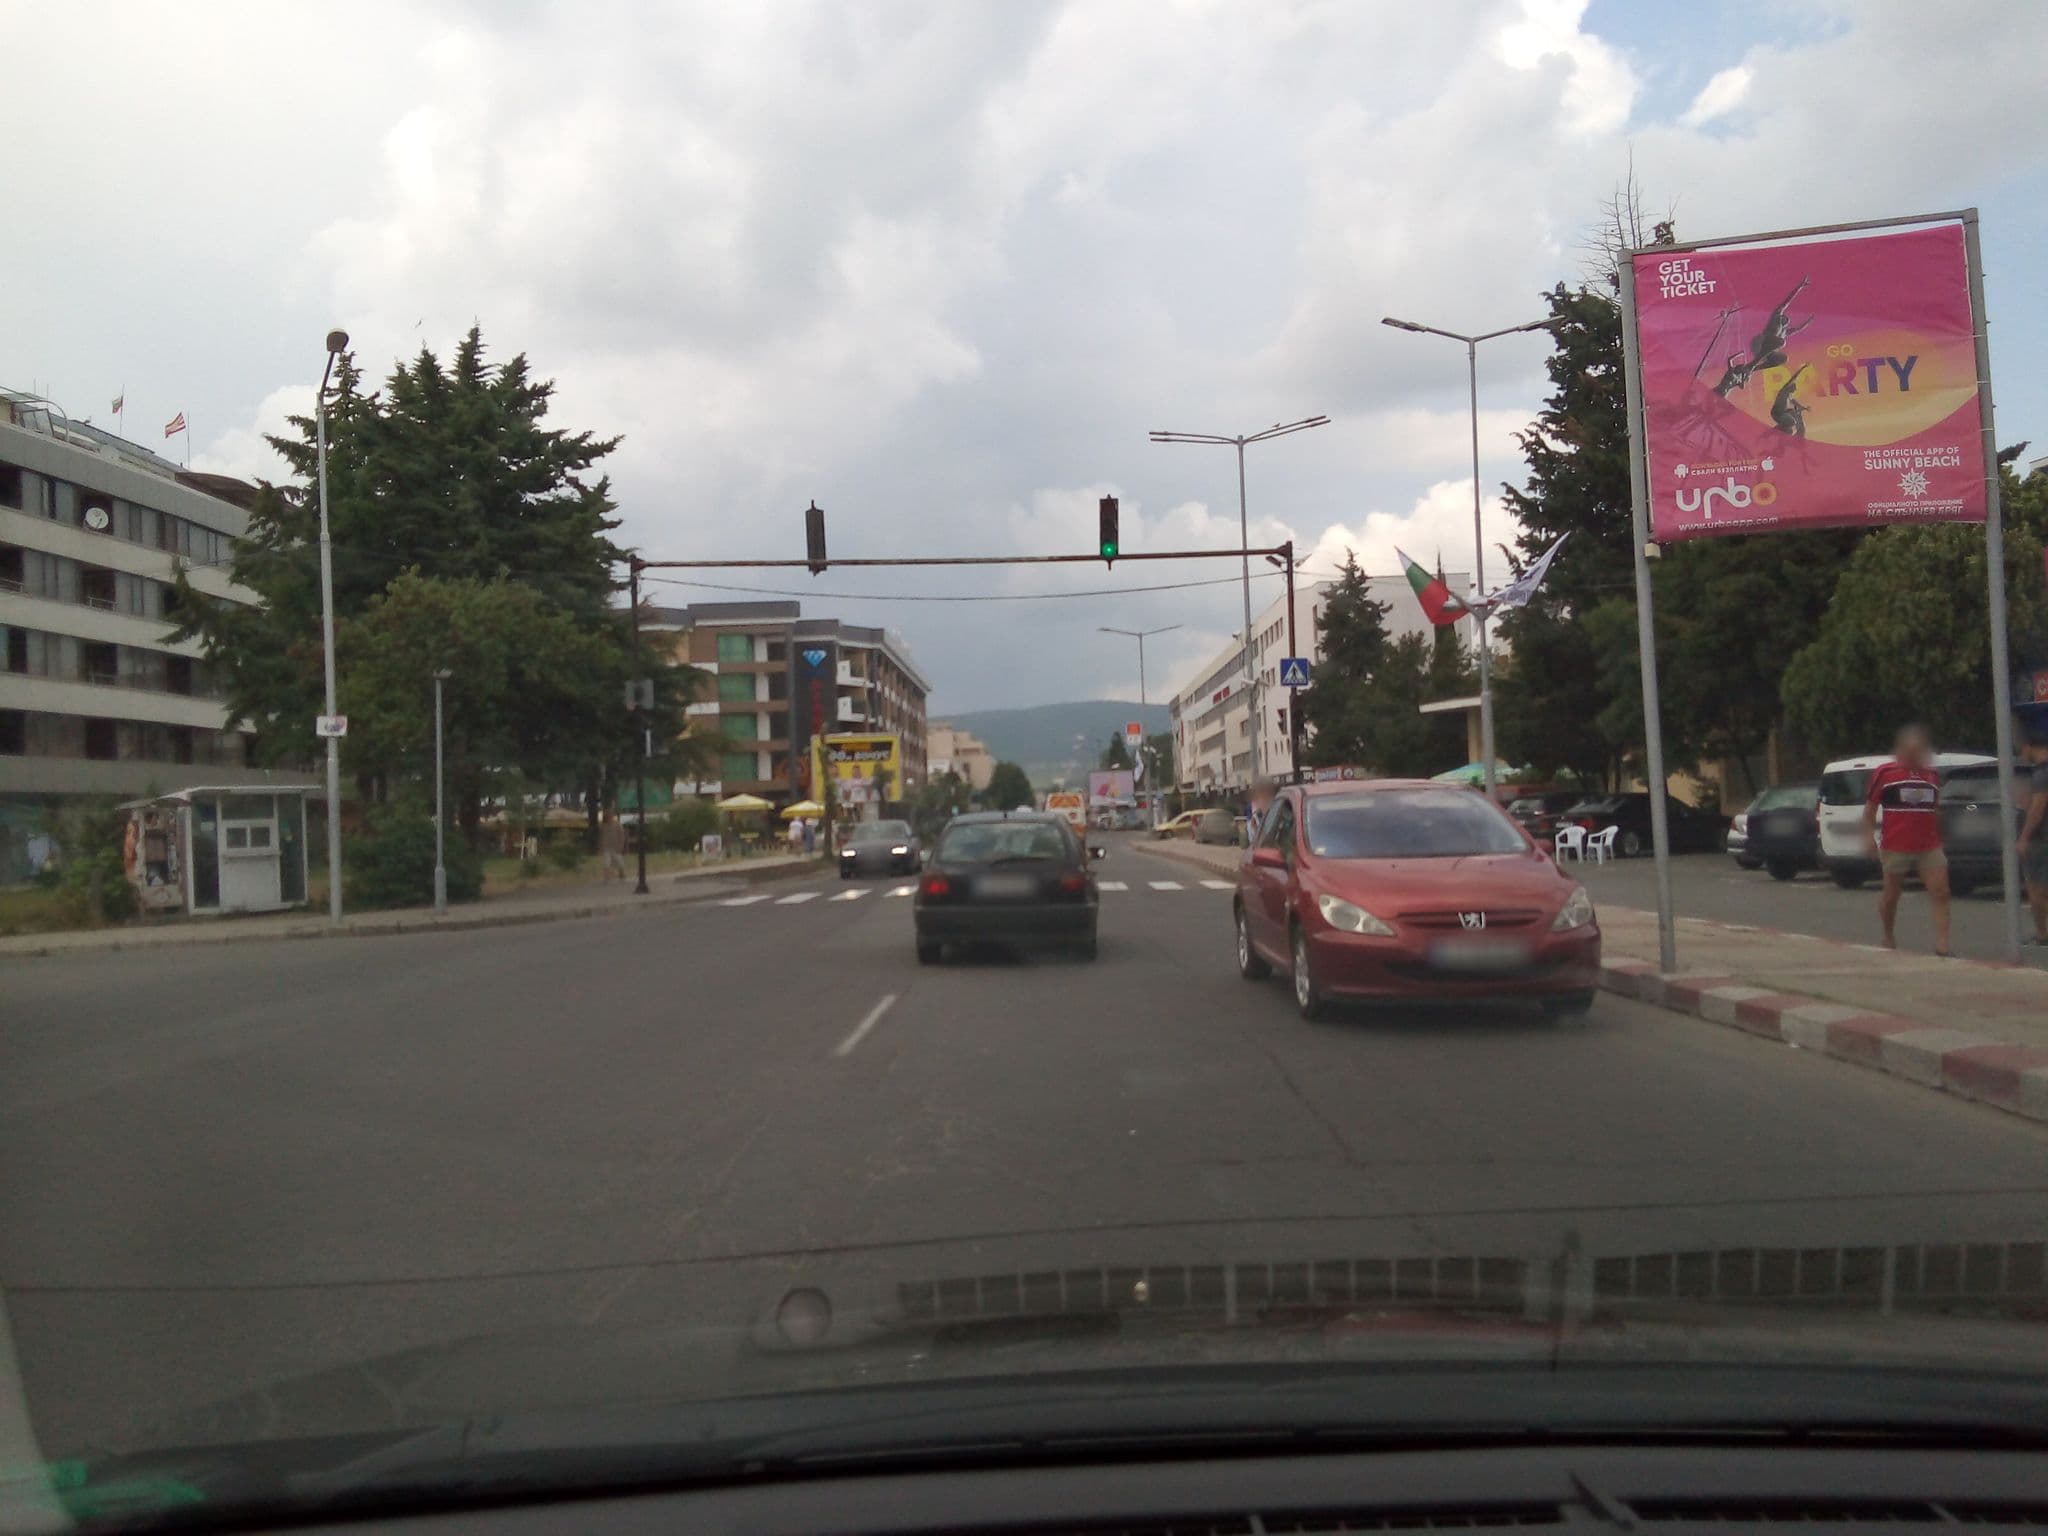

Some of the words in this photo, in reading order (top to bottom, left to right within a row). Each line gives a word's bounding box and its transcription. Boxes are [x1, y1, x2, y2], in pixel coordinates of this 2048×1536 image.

[1658, 259, 1691, 275] GET
[1659, 270, 1706, 287] YOUR
[1660, 280, 1717, 299] TICKET
[1826, 343, 1854, 358] GO
[1763, 355, 1918, 402] PARTY
[1884, 449, 1923, 457] OFFICIAL
[1864, 458, 1910, 470] SUNNY
[1914, 455, 1960, 468] BEACH
[1675, 476, 1777, 519] urbo
